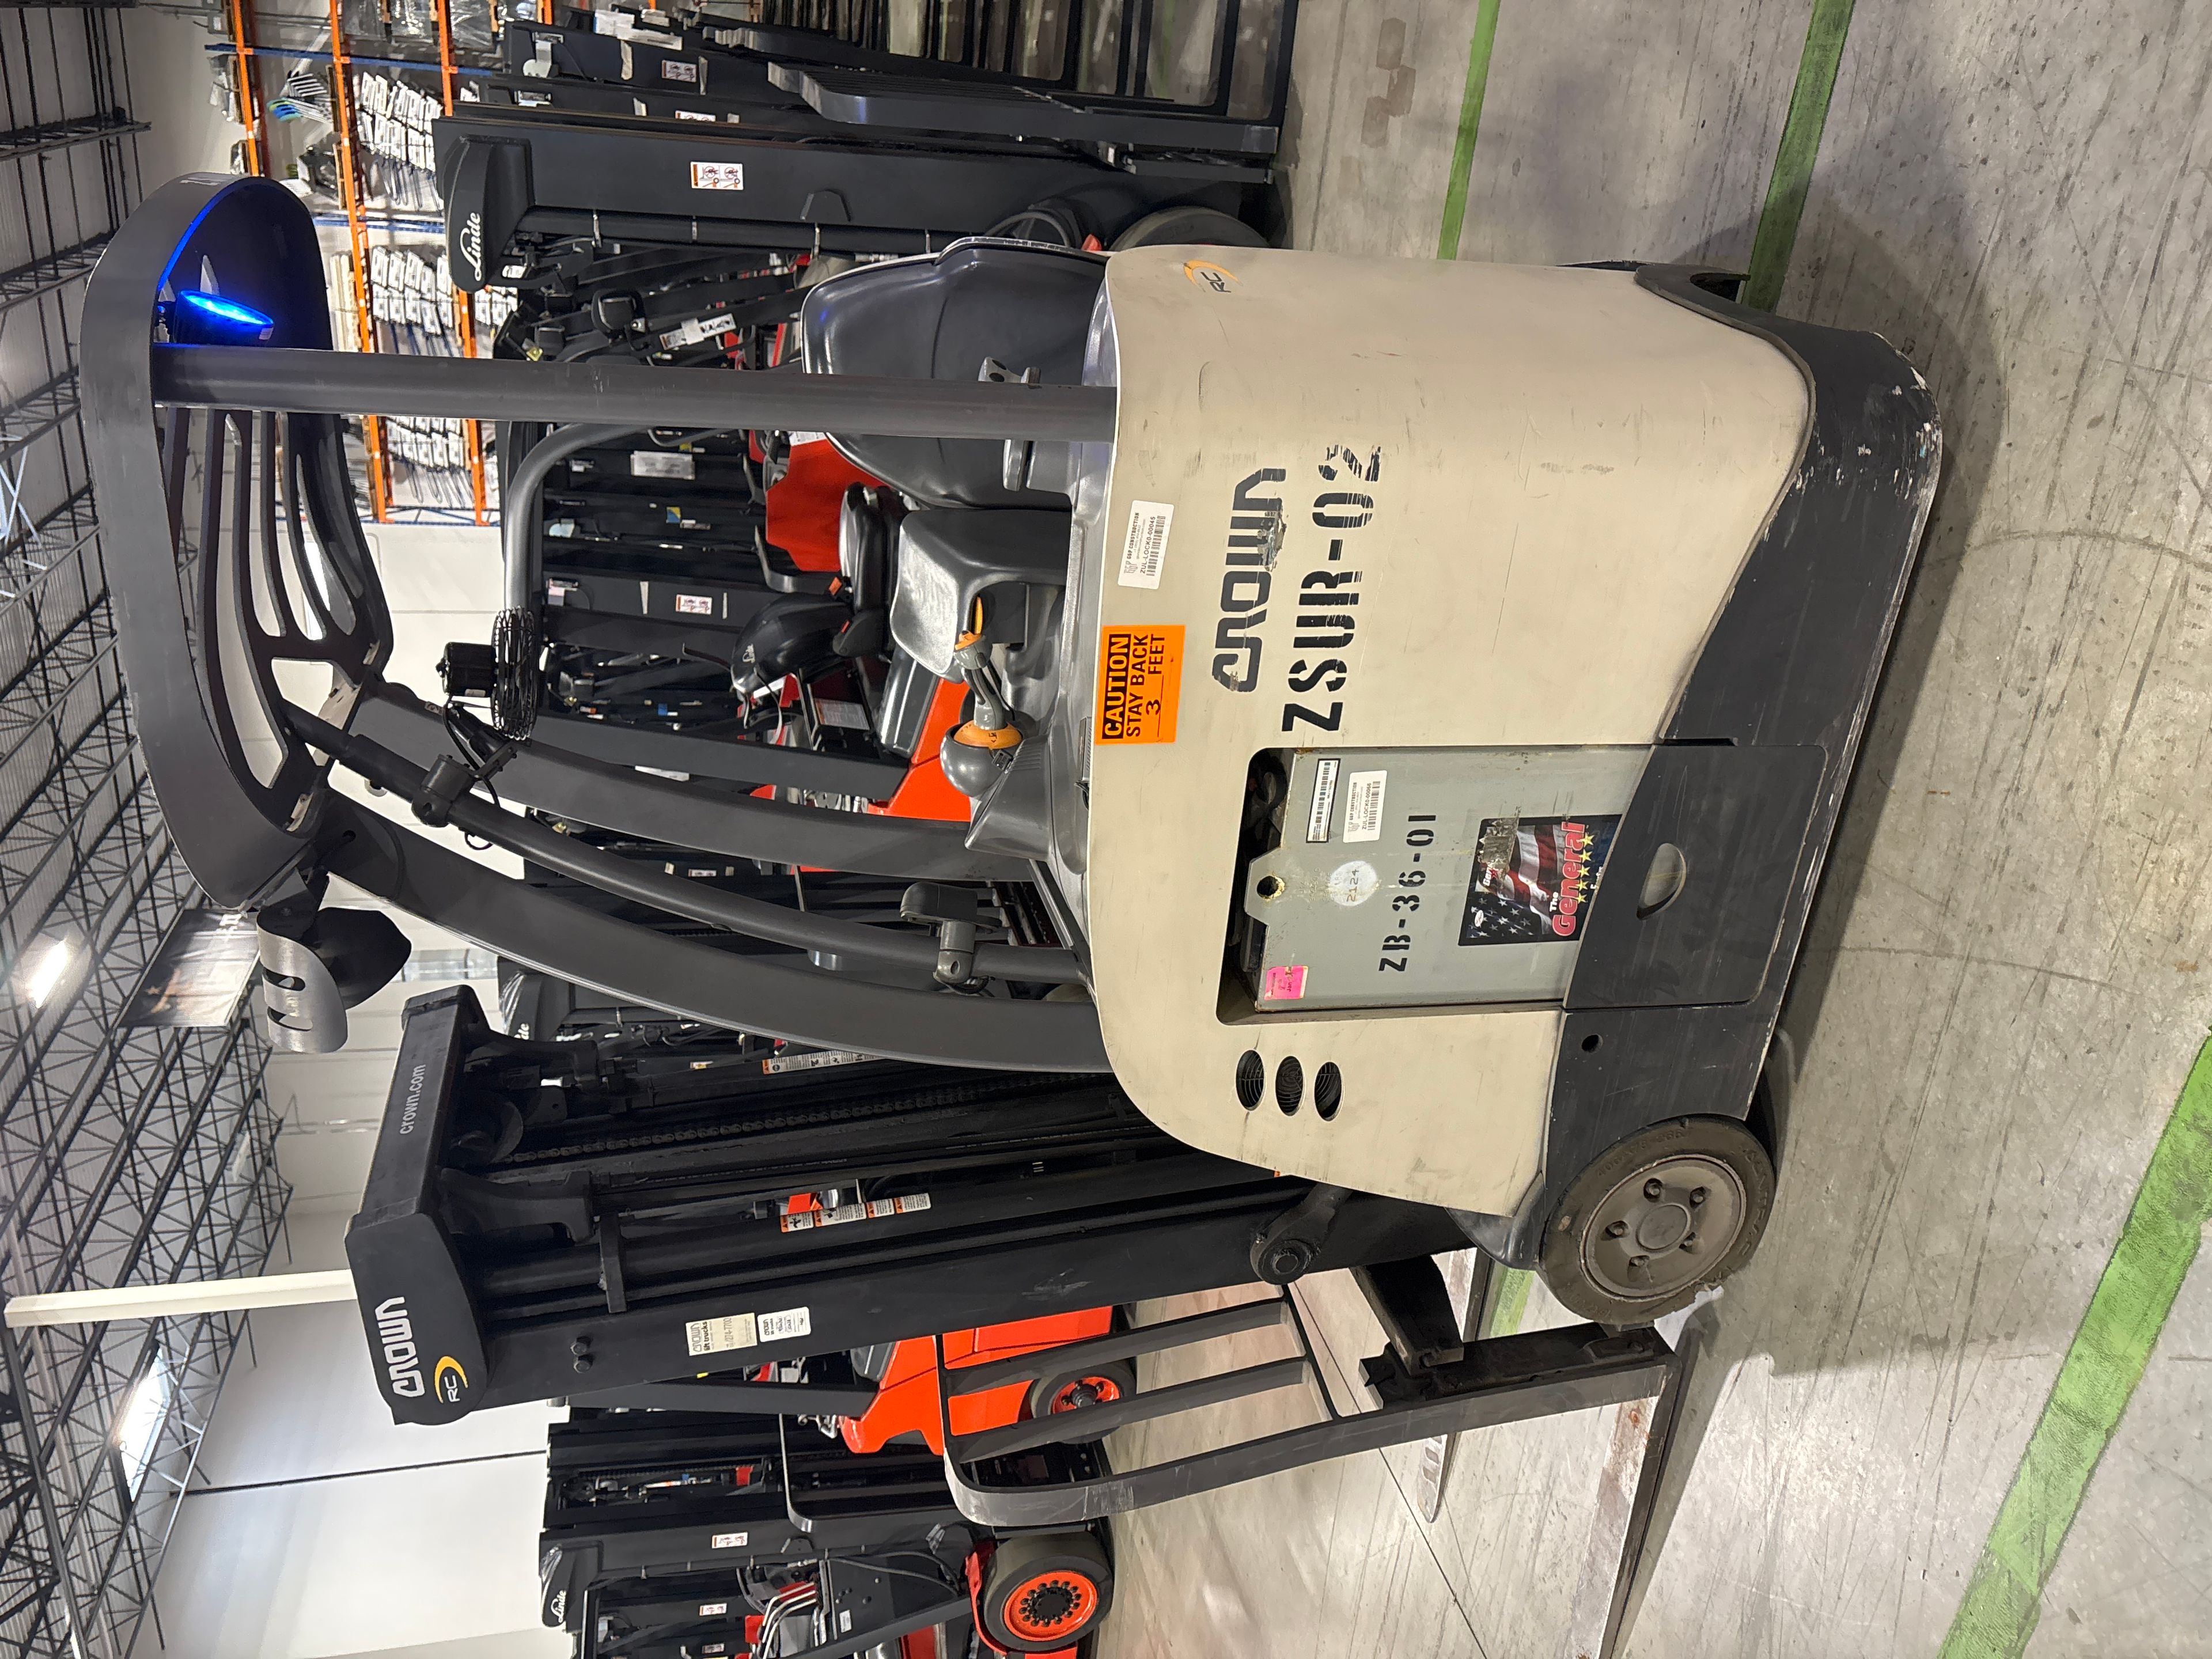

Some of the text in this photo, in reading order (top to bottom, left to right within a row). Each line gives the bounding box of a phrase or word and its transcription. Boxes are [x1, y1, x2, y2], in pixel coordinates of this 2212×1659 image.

[460, 212, 482, 282] Linde
[1200, 271, 1232, 293] RC
[1128, 512, 1139, 549] CONSTRUCTION
[1211, 468, 1286, 692] CROWN
[1281, 444, 1381, 733] ZSUR-02
[1104, 637, 1129, 736] CAUTION
[1126, 634, 1149, 737] STAY BACK
[1145, 633, 1165, 715] 3 FEET
[1346, 869, 1359, 903] 2124
[1378, 814, 1437, 973] ZB-36-01
[1549, 892, 1559, 912] The
[1552, 821, 1585, 937] General
[399, 1064, 426, 1134] crown.com
[374, 1296, 426, 1397] CROWN
[690, 1323, 702, 1352] CROWN
[701, 1321, 710, 1342] trucks
[444, 1375, 460, 1402] RC
[550, 1589, 567, 1623] Linde
